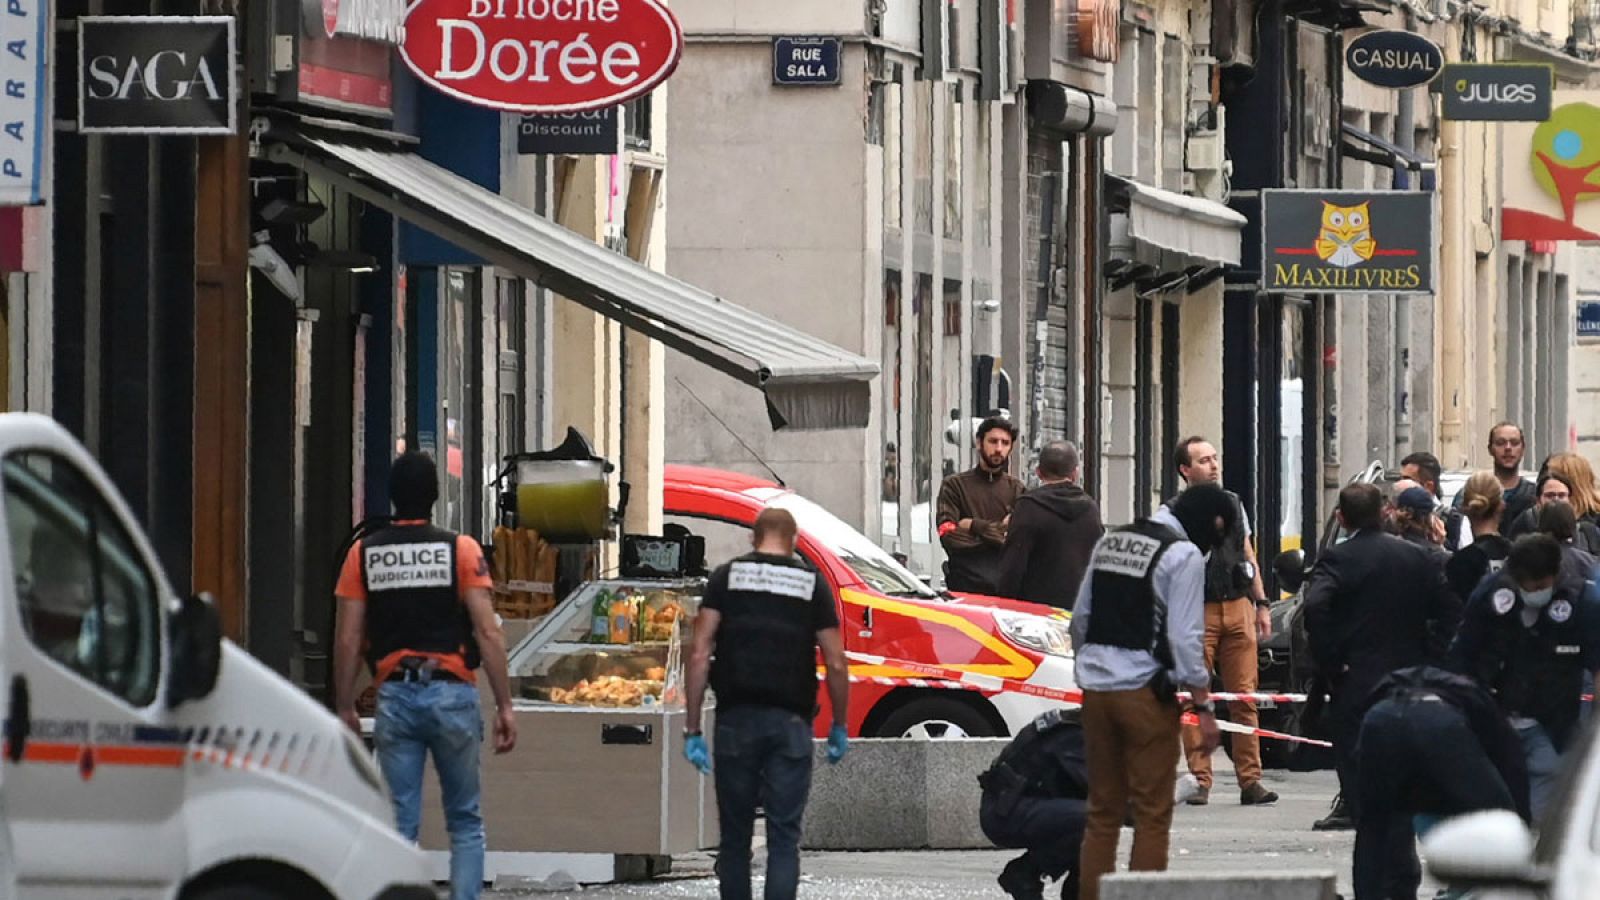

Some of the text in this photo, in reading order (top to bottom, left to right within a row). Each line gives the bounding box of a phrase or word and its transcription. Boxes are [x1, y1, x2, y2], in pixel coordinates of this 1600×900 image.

[434, 18, 641, 85] Dorée
[791, 47, 822, 61] RUE
[1352, 48, 1435, 72] CASUAL
[88, 50, 223, 101] SAGA
[786, 63, 828, 78] SALA
[368, 548, 448, 569] POLICE
[371, 569, 448, 583] JUDICIAIRE
